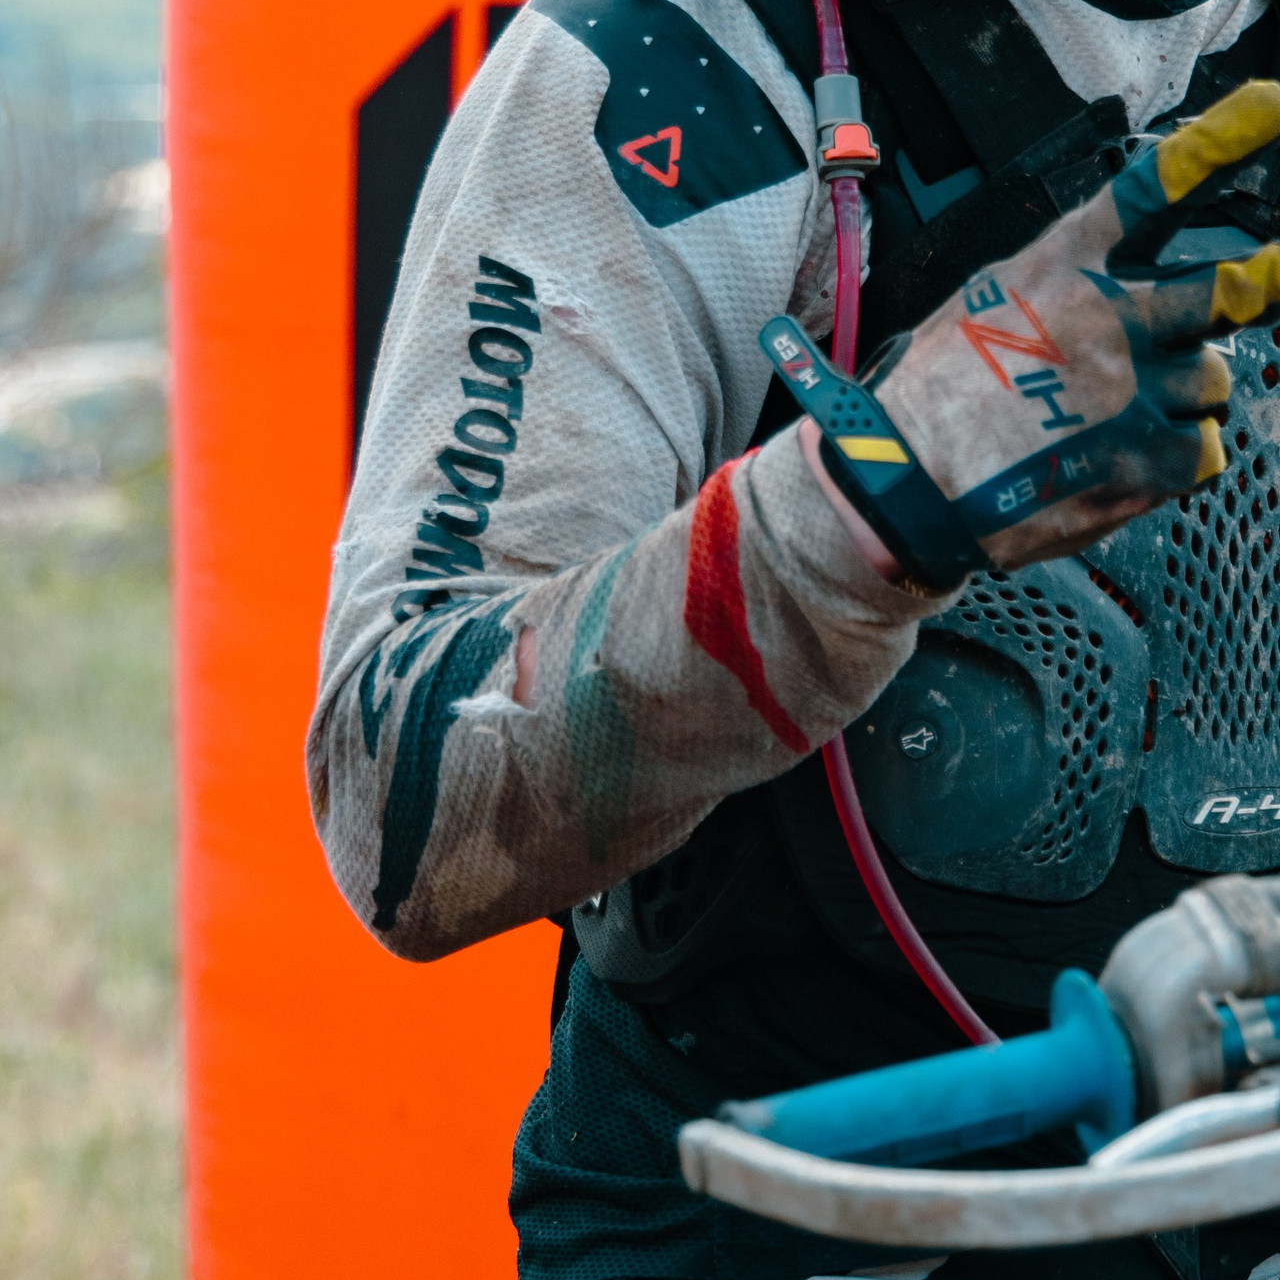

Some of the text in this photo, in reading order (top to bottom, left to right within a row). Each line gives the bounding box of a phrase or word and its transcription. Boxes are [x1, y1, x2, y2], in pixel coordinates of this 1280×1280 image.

[772, 334, 822, 391] HIZER
[957, 271, 1087, 432] HIZE
[997, 452, 1092, 515] HIZER
